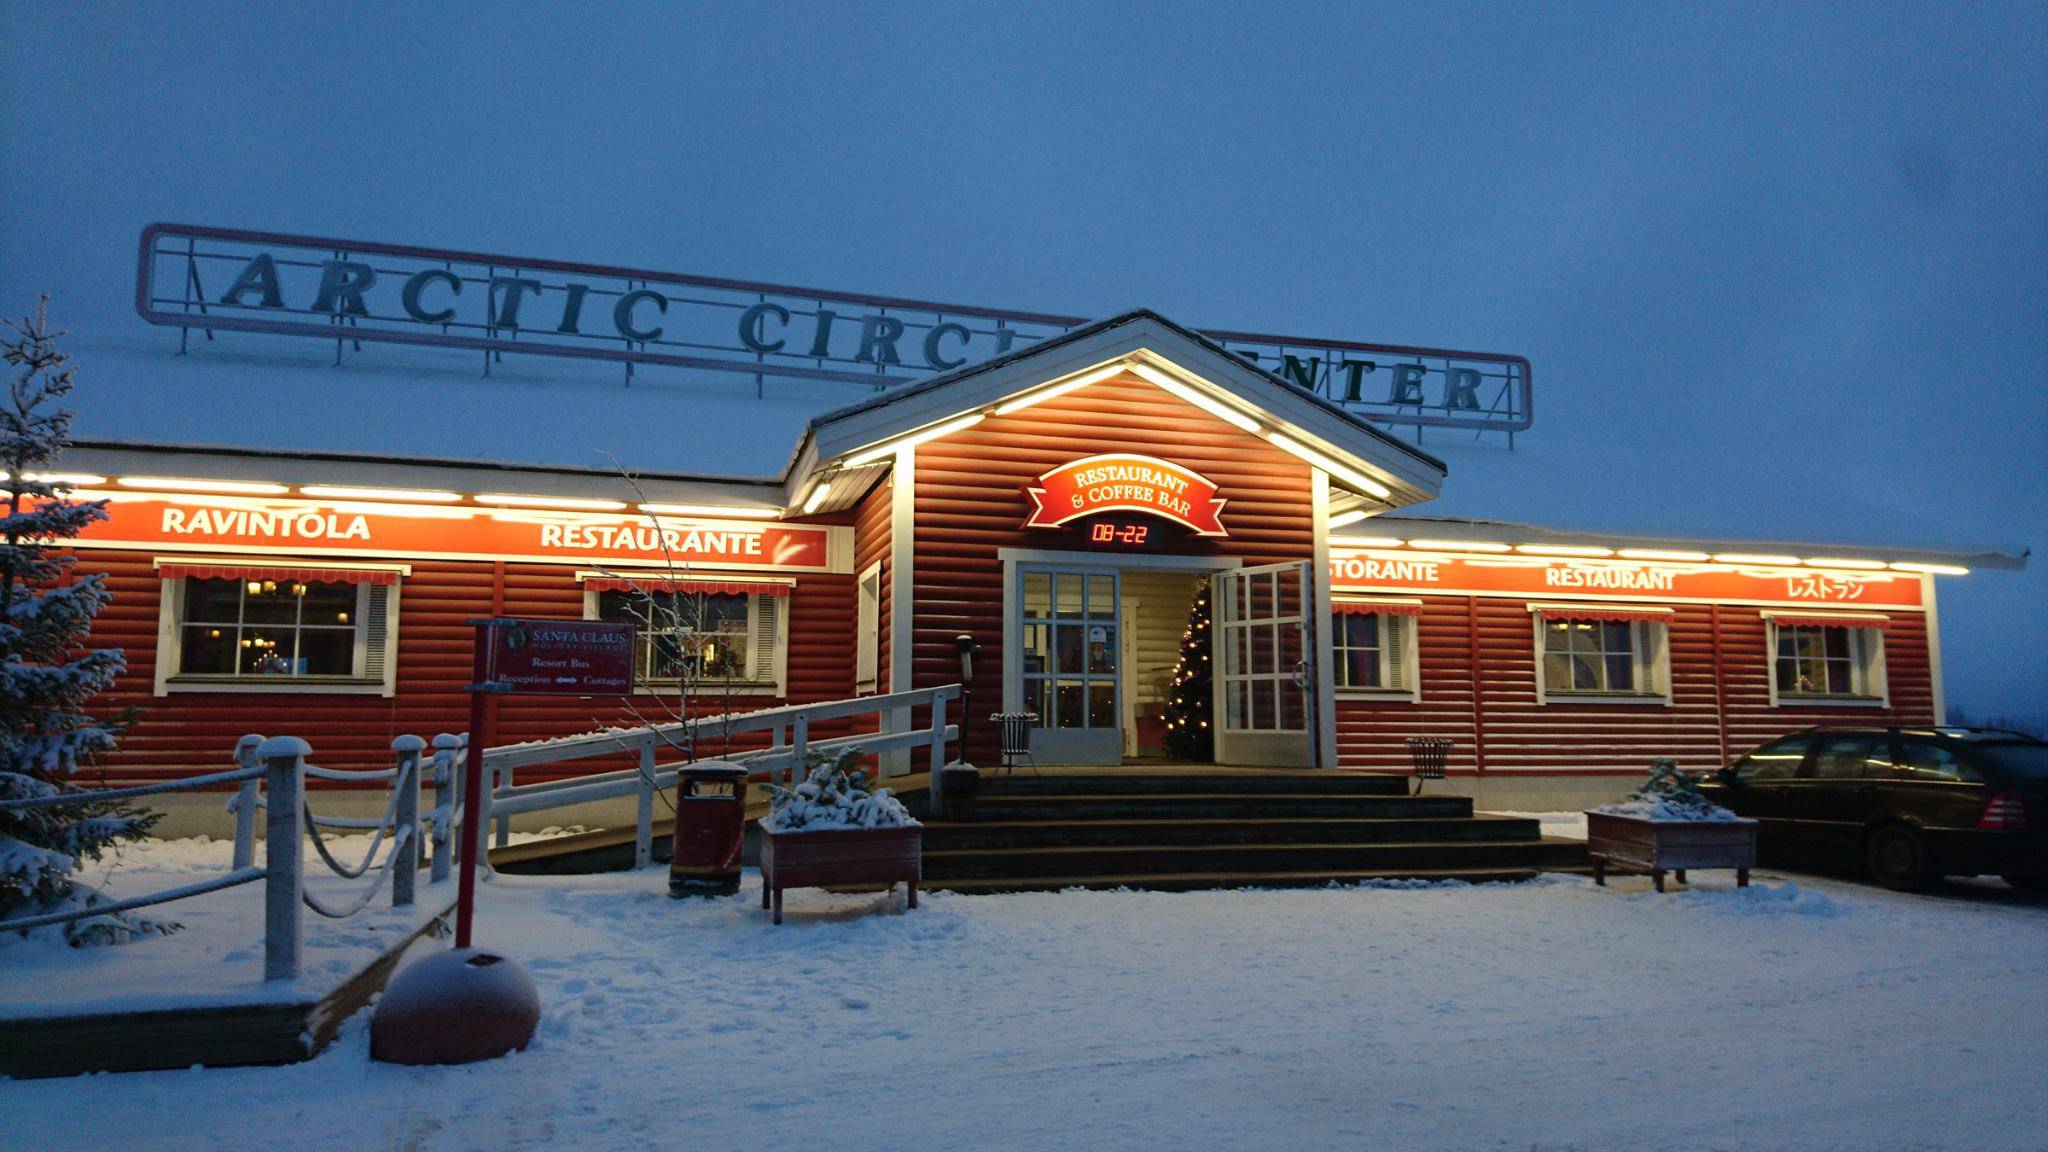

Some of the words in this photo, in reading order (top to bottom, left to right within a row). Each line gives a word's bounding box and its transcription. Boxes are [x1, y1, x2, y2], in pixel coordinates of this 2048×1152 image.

[220, 252, 668, 343] ARCTIC
[1235, 350, 1483, 410] NTER
[1074, 466, 1189, 494] RESTAURANT
[1071, 493, 1084, 508] &
[1089, 485, 1154, 503] COFFEE
[1158, 491, 1191, 517] BAR
[161, 507, 371, 540] RAVINTOLA
[1092, 523, 1148, 543] 08-22
[541, 524, 762, 555] RESTAURANTE
[1546, 567, 1676, 590] RESTAURANT
[1787, 577, 1864, 599] レストラン
[532, 631, 578, 643] SANTA
[582, 632, 626, 644] CLAUS
[532, 656, 567, 668] Resort
[570, 657, 590, 668] Bus
[499, 673, 551, 684] Reception
[583, 675, 626, 686] Cottages
